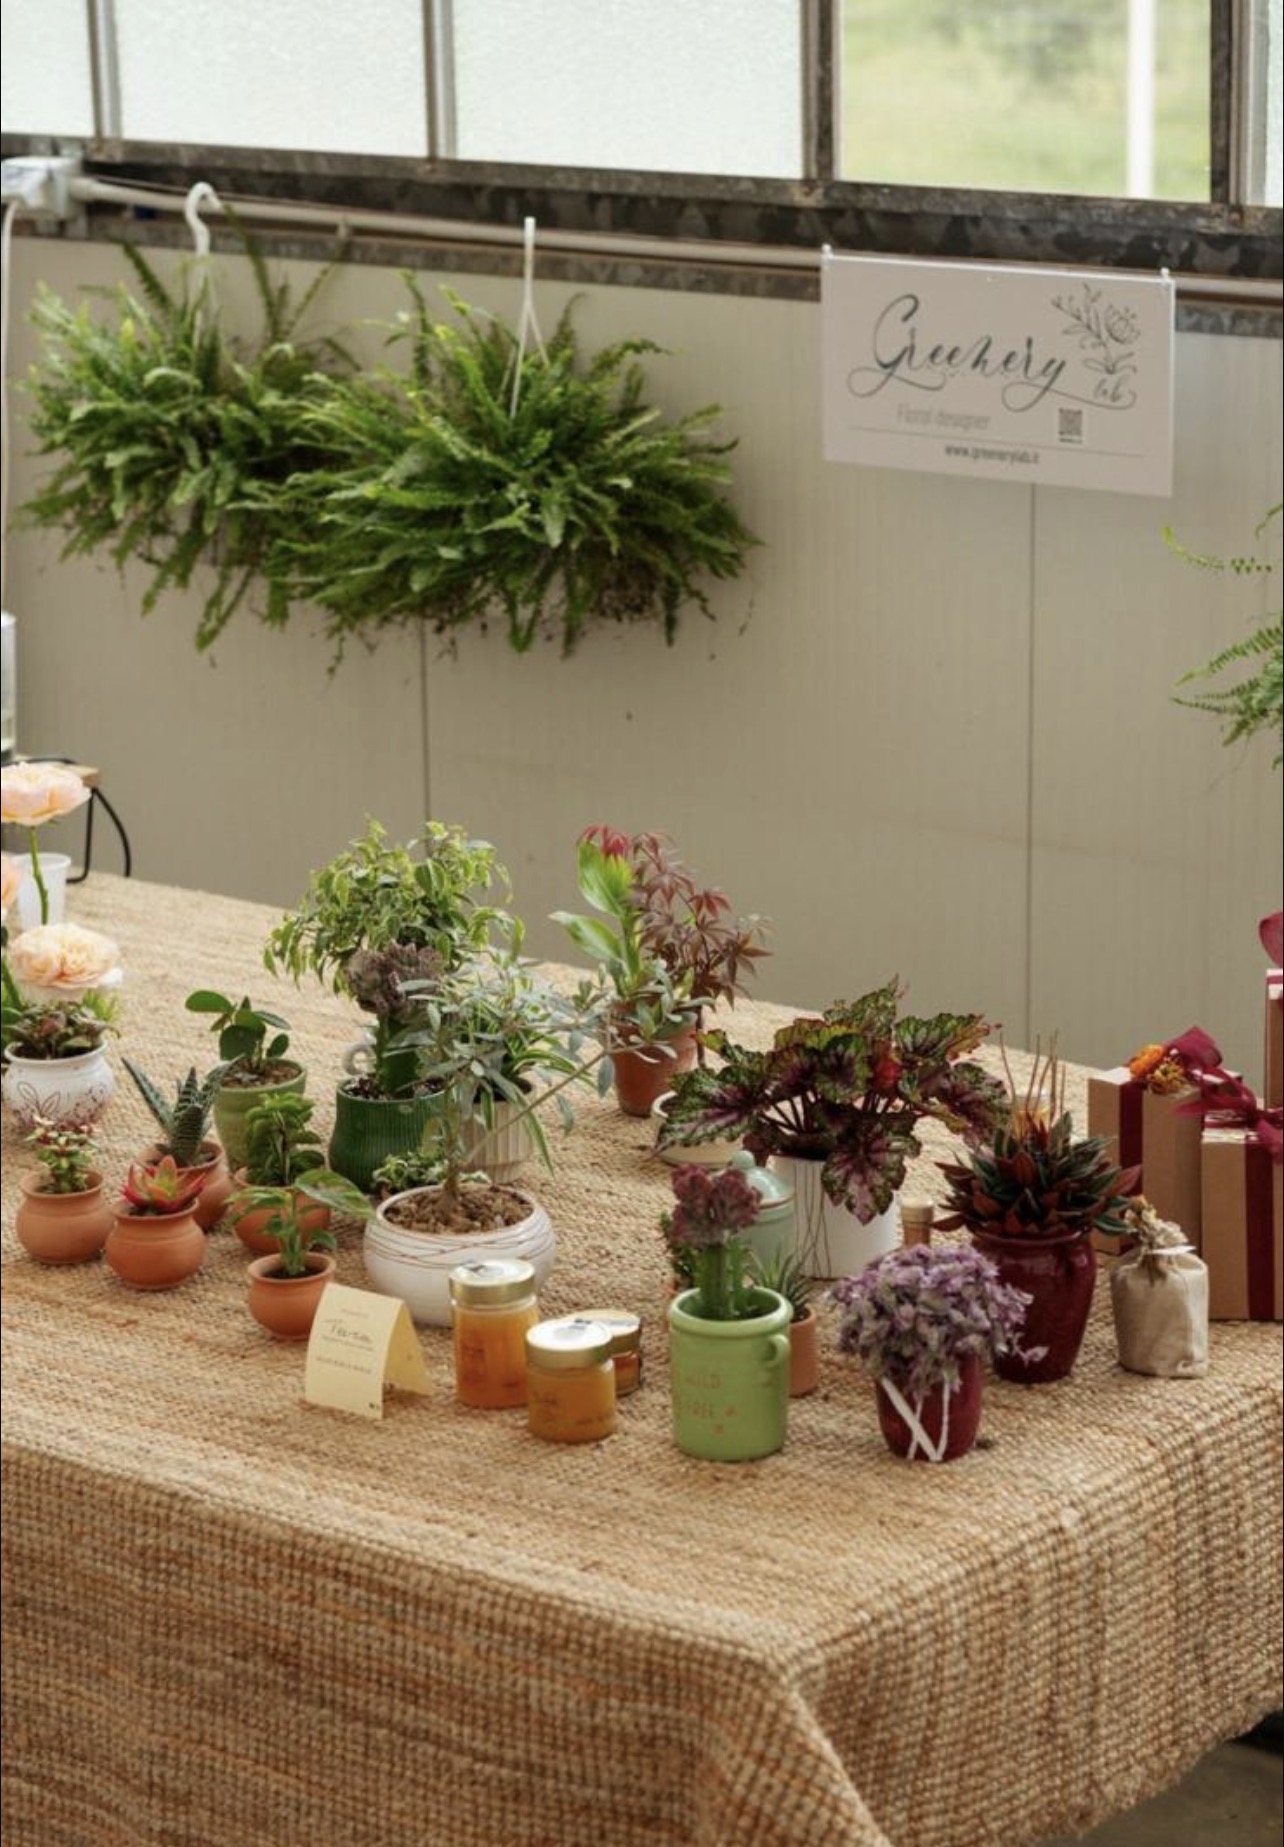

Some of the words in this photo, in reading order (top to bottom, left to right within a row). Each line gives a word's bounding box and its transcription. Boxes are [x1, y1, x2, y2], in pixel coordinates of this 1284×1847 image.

[847, 294, 1068, 412] Greenery
[897, 402, 932, 425] Floral
[935, 407, 991, 432] designer
[945, 446, 1040, 466] www.greenerylab.it
